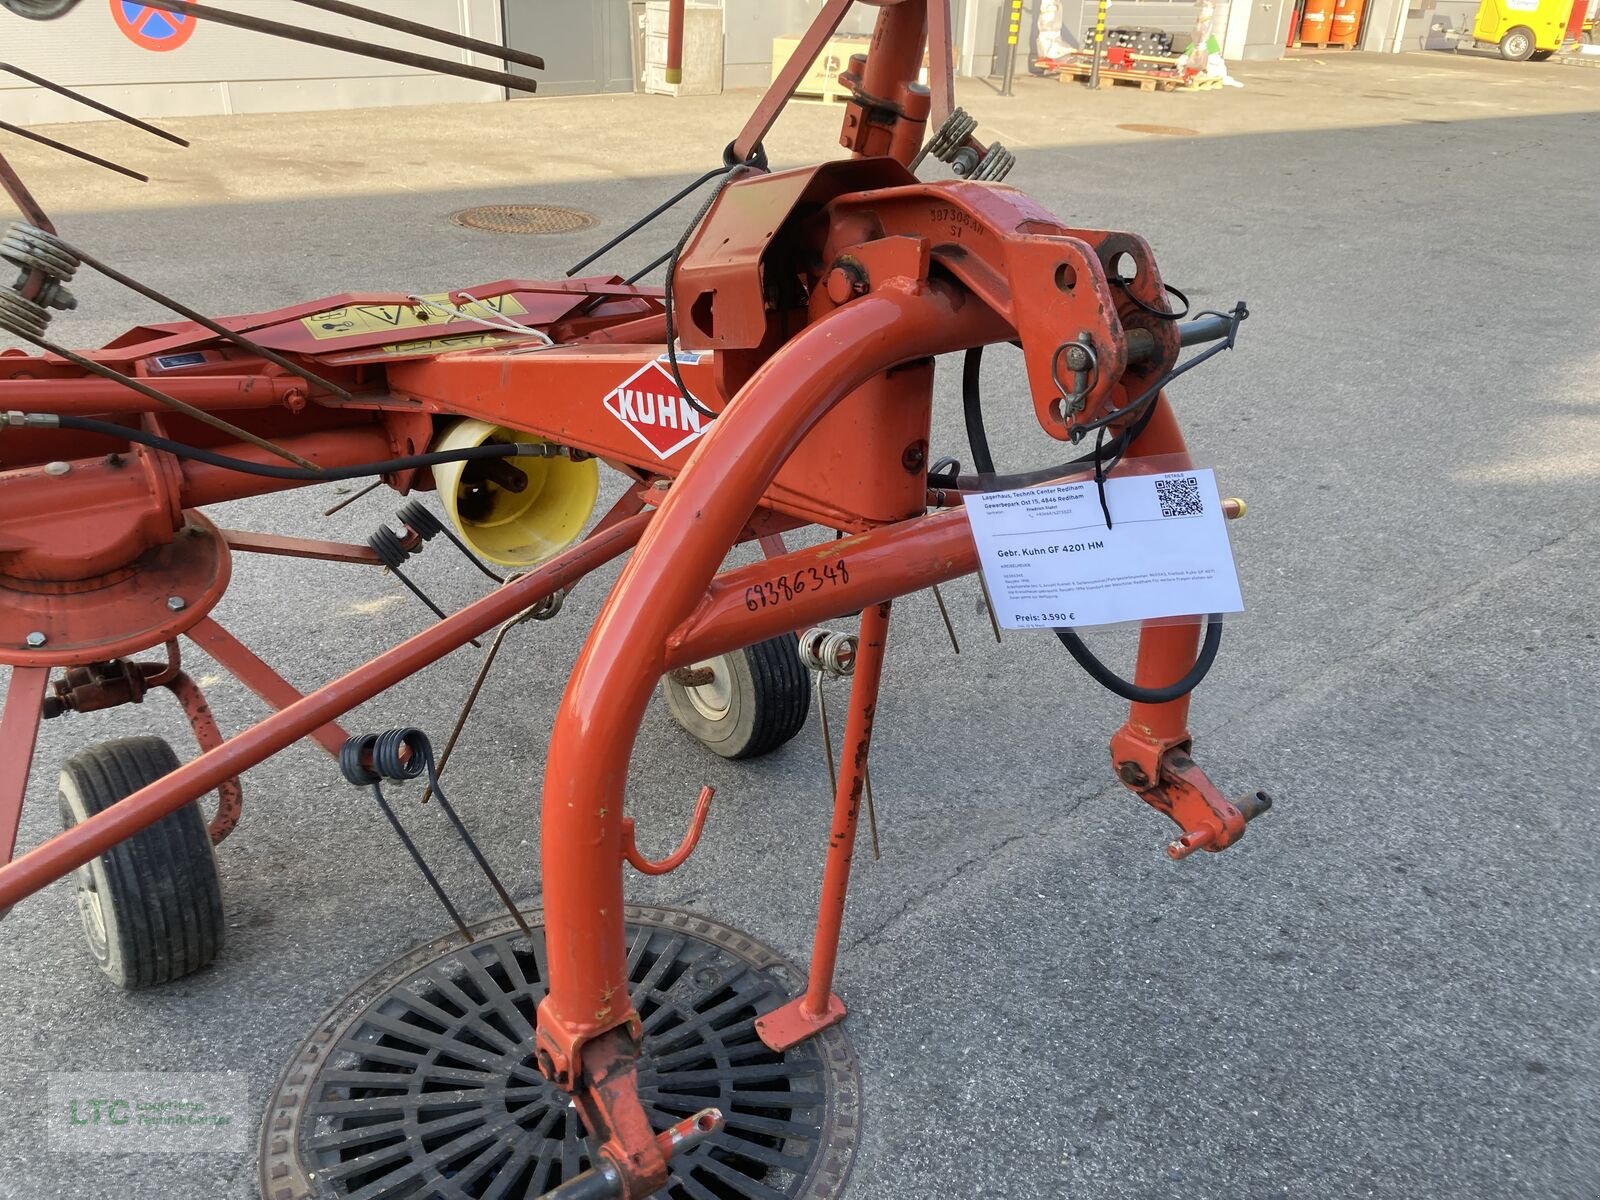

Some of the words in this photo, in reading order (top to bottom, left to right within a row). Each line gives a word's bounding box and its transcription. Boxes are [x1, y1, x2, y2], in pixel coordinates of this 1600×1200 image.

[617, 388, 701, 433] KUHN
[1013, 490, 1035, 498] Technik
[1057, 485, 1084, 493] Redlham
[984, 501, 1019, 509] Gewerbepark
[1031, 498, 1040, 506] 15,
[997, 549, 1021, 558] Gebr.
[1022, 548, 1046, 556] Kuhn
[1047, 546, 1060, 554] GF
[1062, 544, 1085, 552] 4201
[1087, 541, 1104, 550] HM
[1015, 613, 1040, 622] Preis:
[1041, 613, 1067, 621] 3.590
[1069, 612, 1076, 620] €
